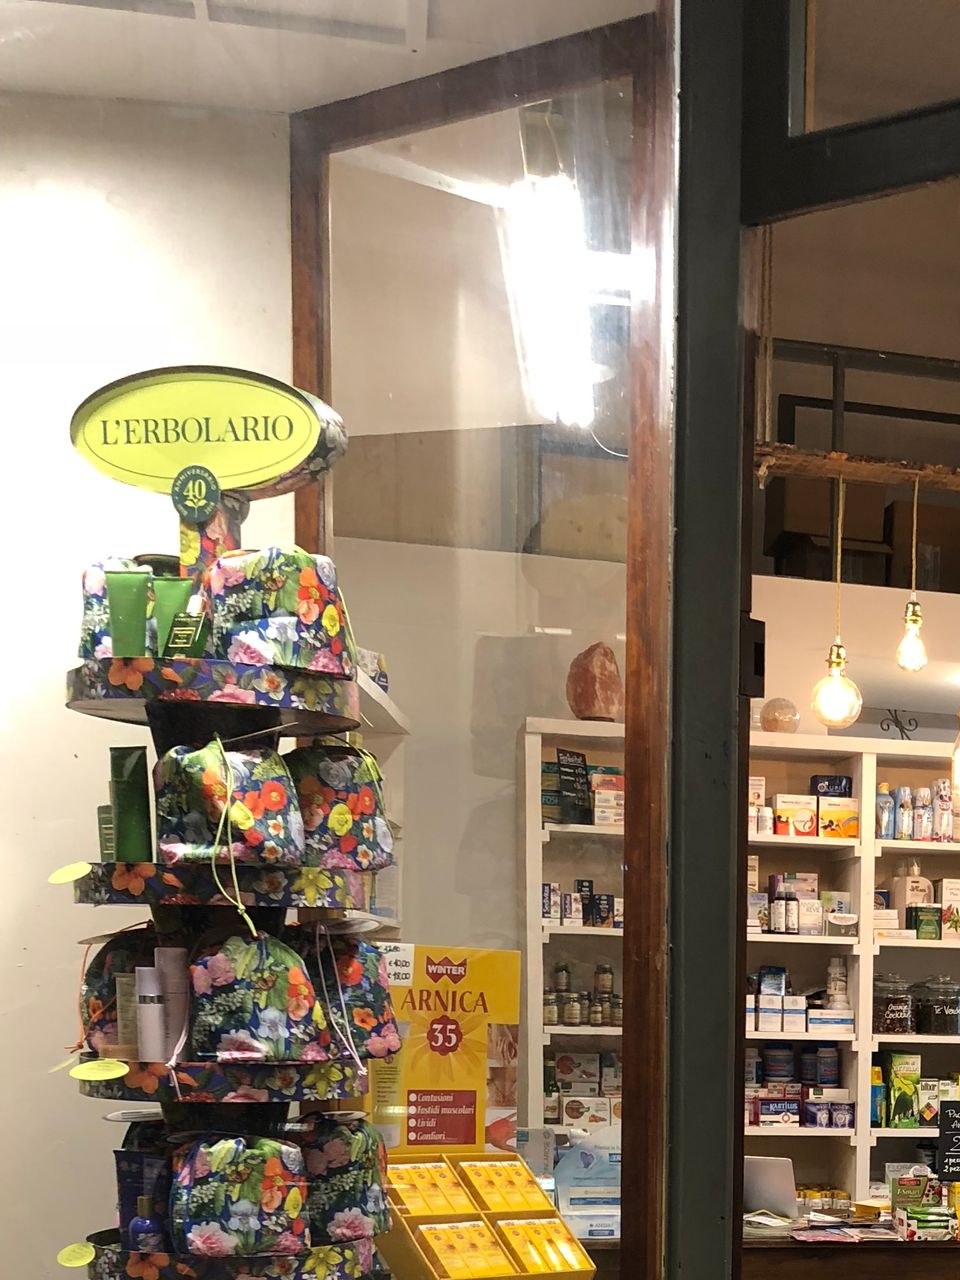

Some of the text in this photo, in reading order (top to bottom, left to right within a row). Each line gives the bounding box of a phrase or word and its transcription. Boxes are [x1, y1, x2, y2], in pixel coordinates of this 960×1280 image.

[101, 415, 294, 445] L'ERBOLARIO
[183, 479, 207, 500] 40
[427, 965, 465, 975] WINTER
[400, 989, 488, 1013] ARNICA
[431, 1024, 457, 1047] 35
[418, 1093, 453, 1101] Contusioni
[417, 1105, 474, 1114] Fastidi muscolari
